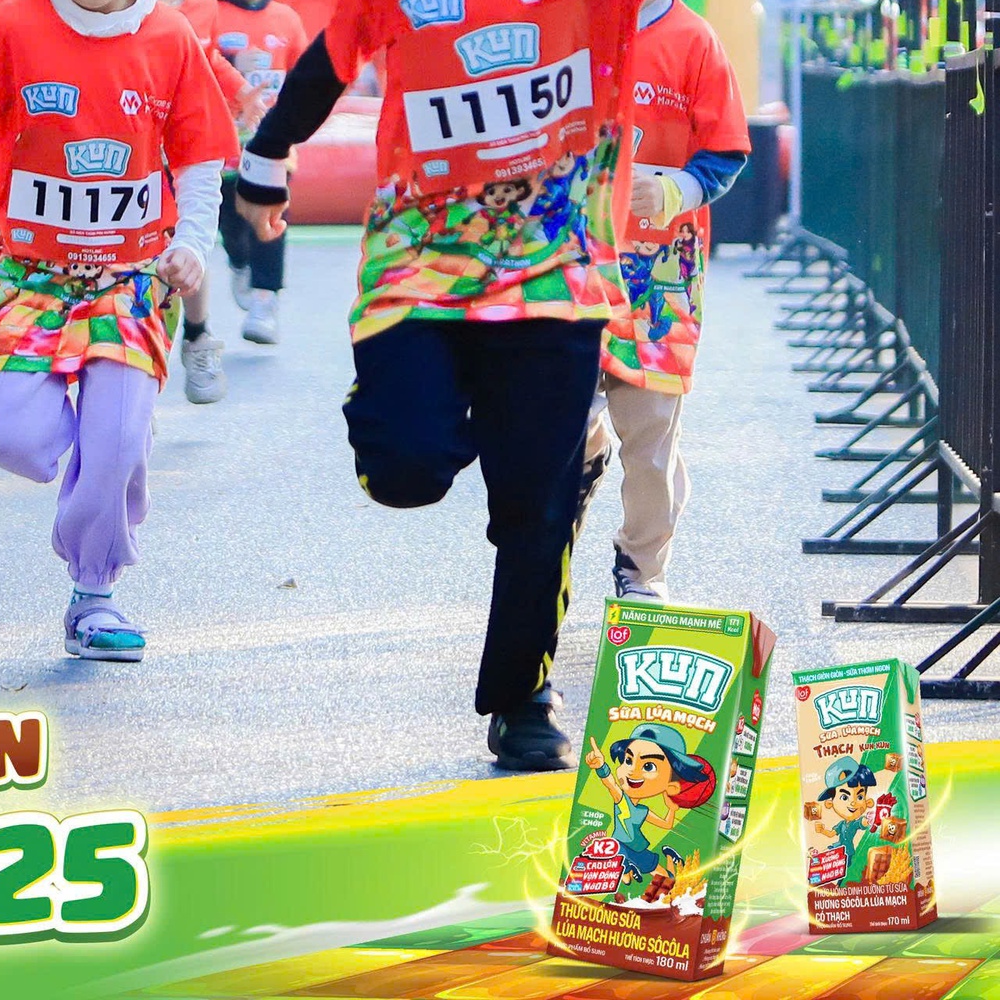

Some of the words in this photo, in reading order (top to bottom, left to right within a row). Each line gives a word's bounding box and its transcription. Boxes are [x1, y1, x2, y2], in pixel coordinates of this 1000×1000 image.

[460, 28, 535, 70] KUN
[25, 85, 76, 112] KUN
[429, 65, 573, 139] 11150
[67, 143, 124, 173] KUN
[33, 179, 149, 223] 11179
[622, 611, 647, 622] NĂNG
[648, 614, 678, 625] LƯỢNG
[679, 617, 706, 628] MẠNH
[623, 652, 728, 708] KUN
[608, 706, 642, 722] SỮA
[818, 690, 880, 725] KUN
[813, 744, 854, 758] THẠCH
[581, 831, 607, 846] VITAMIN
[594, 841, 615, 854] K2
[586, 862, 602, 870] CAO
[814, 899, 840, 910] HƯƠNG
[886, 896, 907, 907] MẠCH
[560, 902, 588, 921] THỨC
[618, 910, 641, 930] SỮA
[826, 911, 850, 922] THẠCH
[887, 916, 900, 925] 170
[900, 916, 910, 924] ml
[556, 919, 576, 938] LÚA
[576, 925, 608, 945] MẠCH
[608, 931, 647, 951] HƯƠNG
[647, 934, 690, 959] SÔCÔLA
[656, 956, 674, 968] 180
[675, 960, 688, 971] ml
